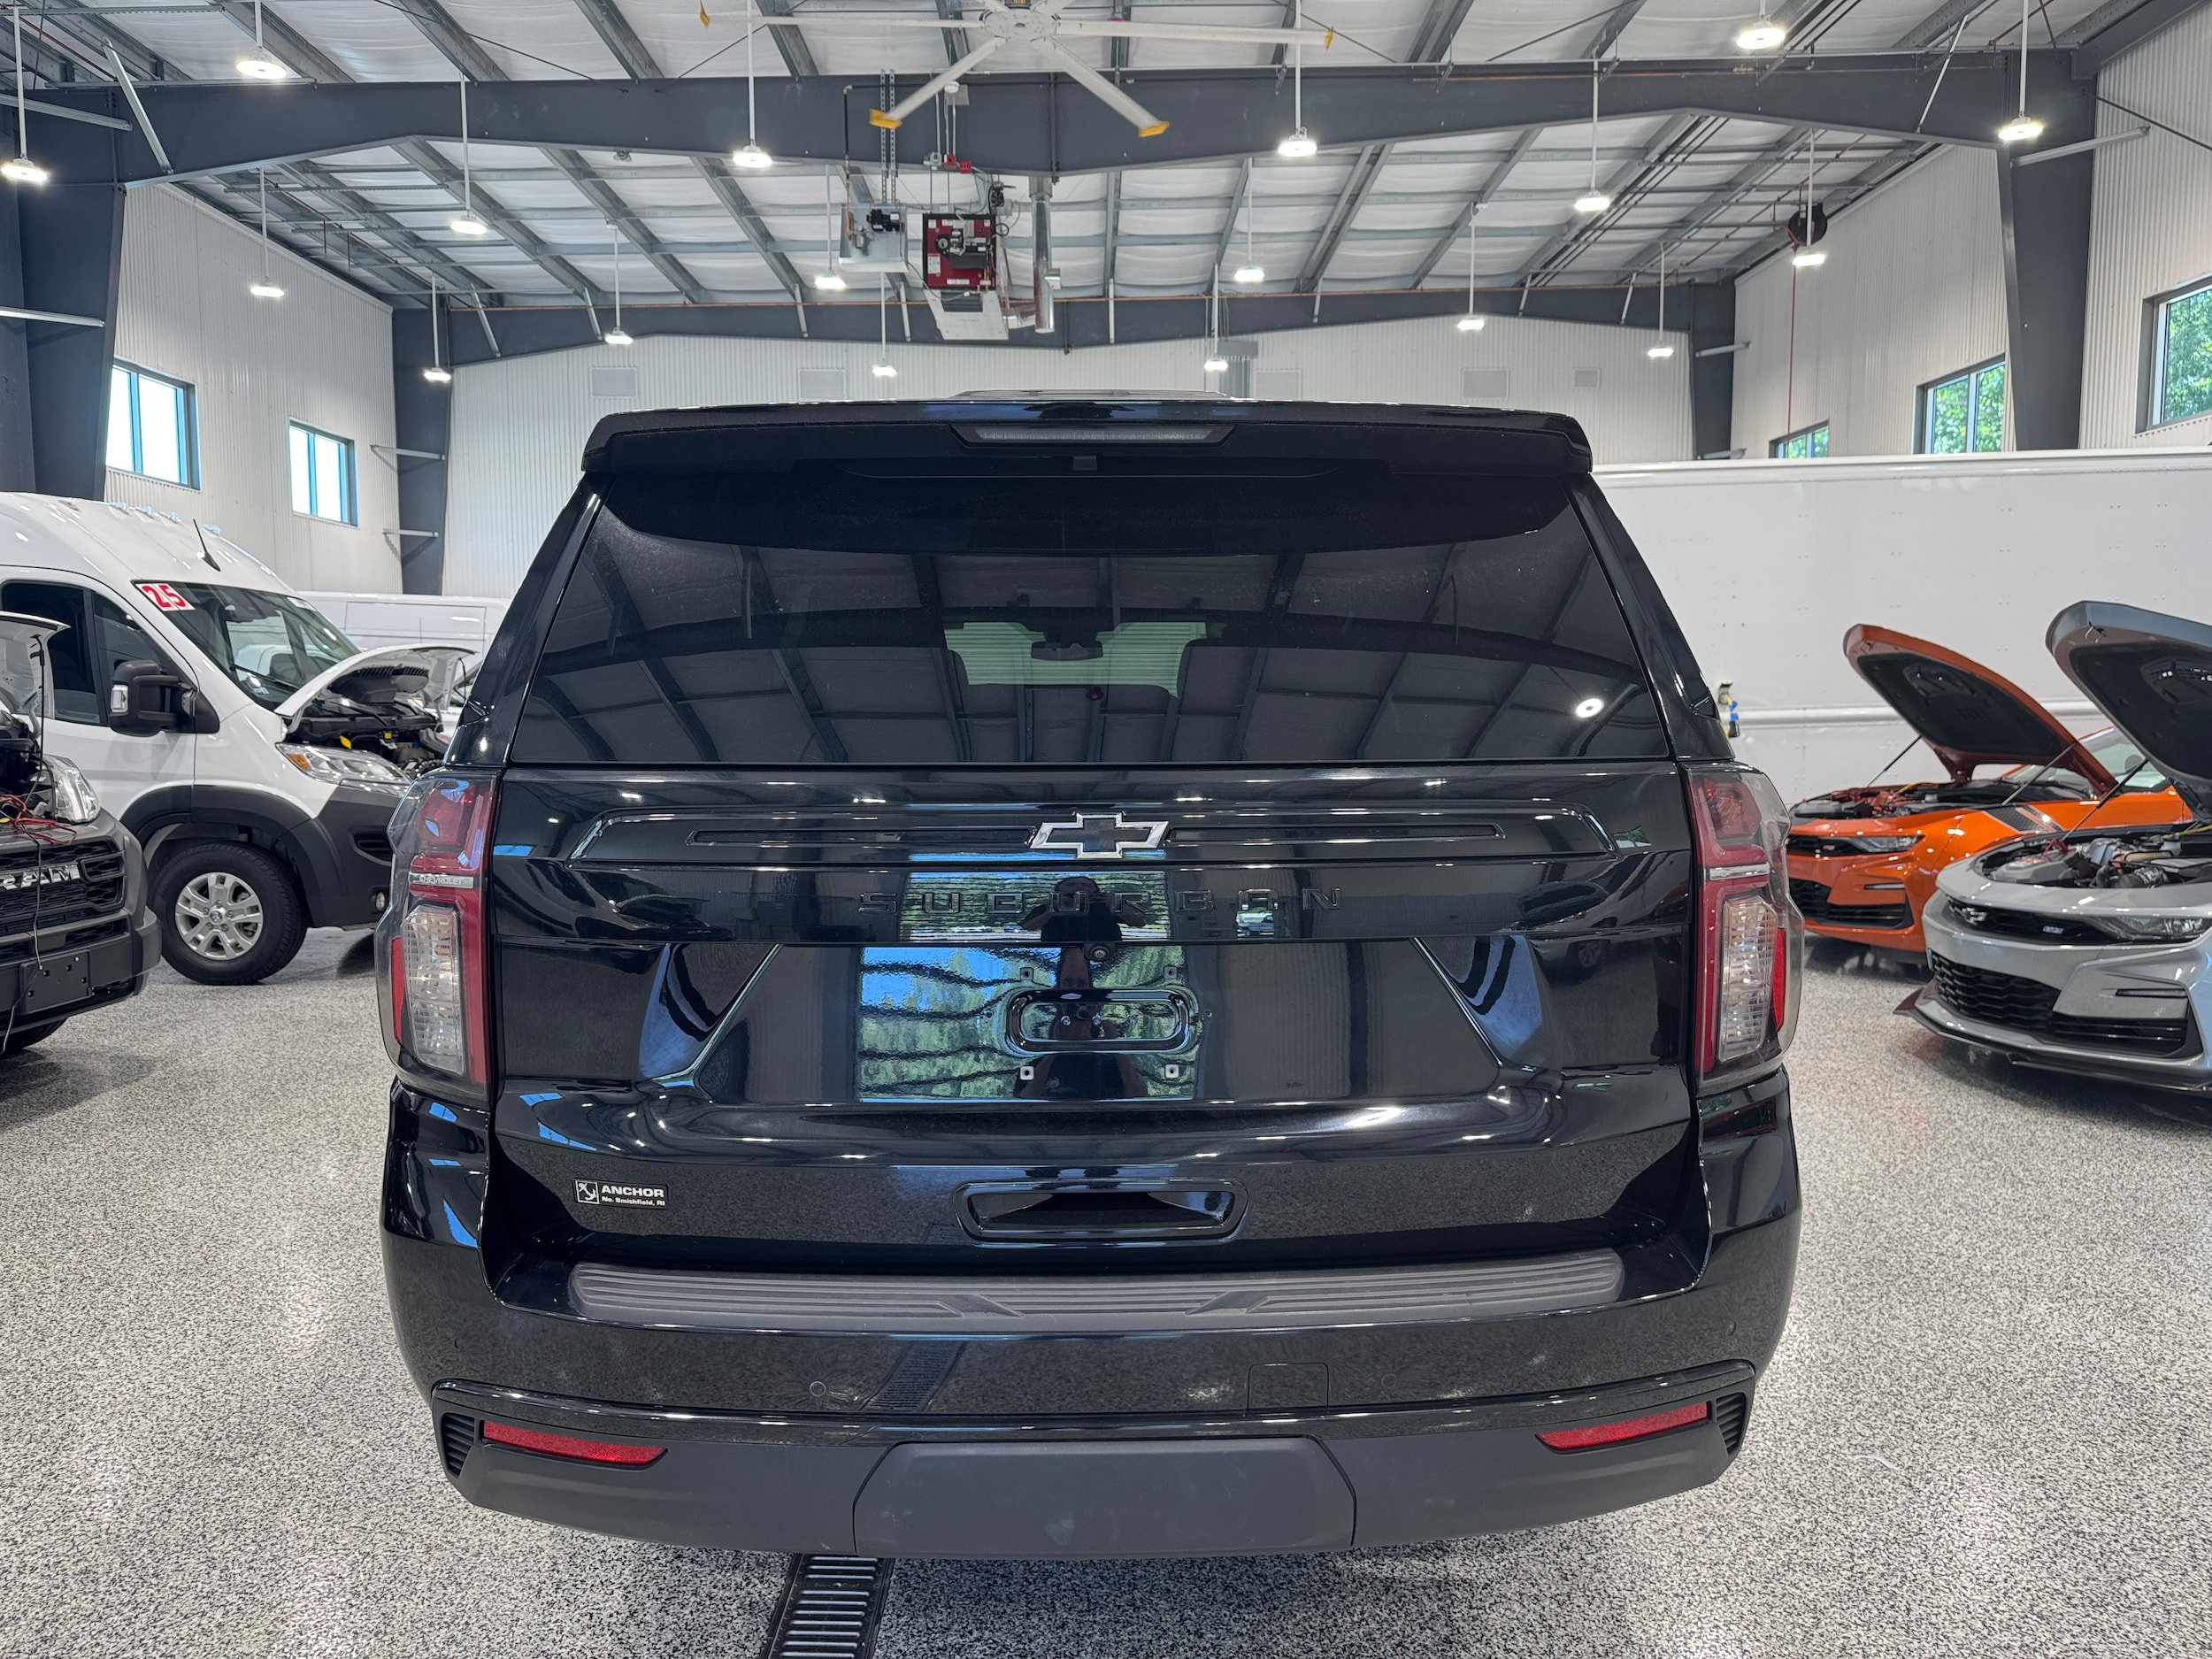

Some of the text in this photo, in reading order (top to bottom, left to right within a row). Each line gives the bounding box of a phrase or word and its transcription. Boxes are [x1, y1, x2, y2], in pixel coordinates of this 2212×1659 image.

[141, 585, 187, 608] 25
[0, 864, 81, 890] RAM
[419, 875, 463, 886] CHEVROLET
[858, 888, 1341, 914] SUBURBAN
[602, 1185, 664, 1197] ANCHOR
[615, 1197, 656, 1206] Smithfield,
